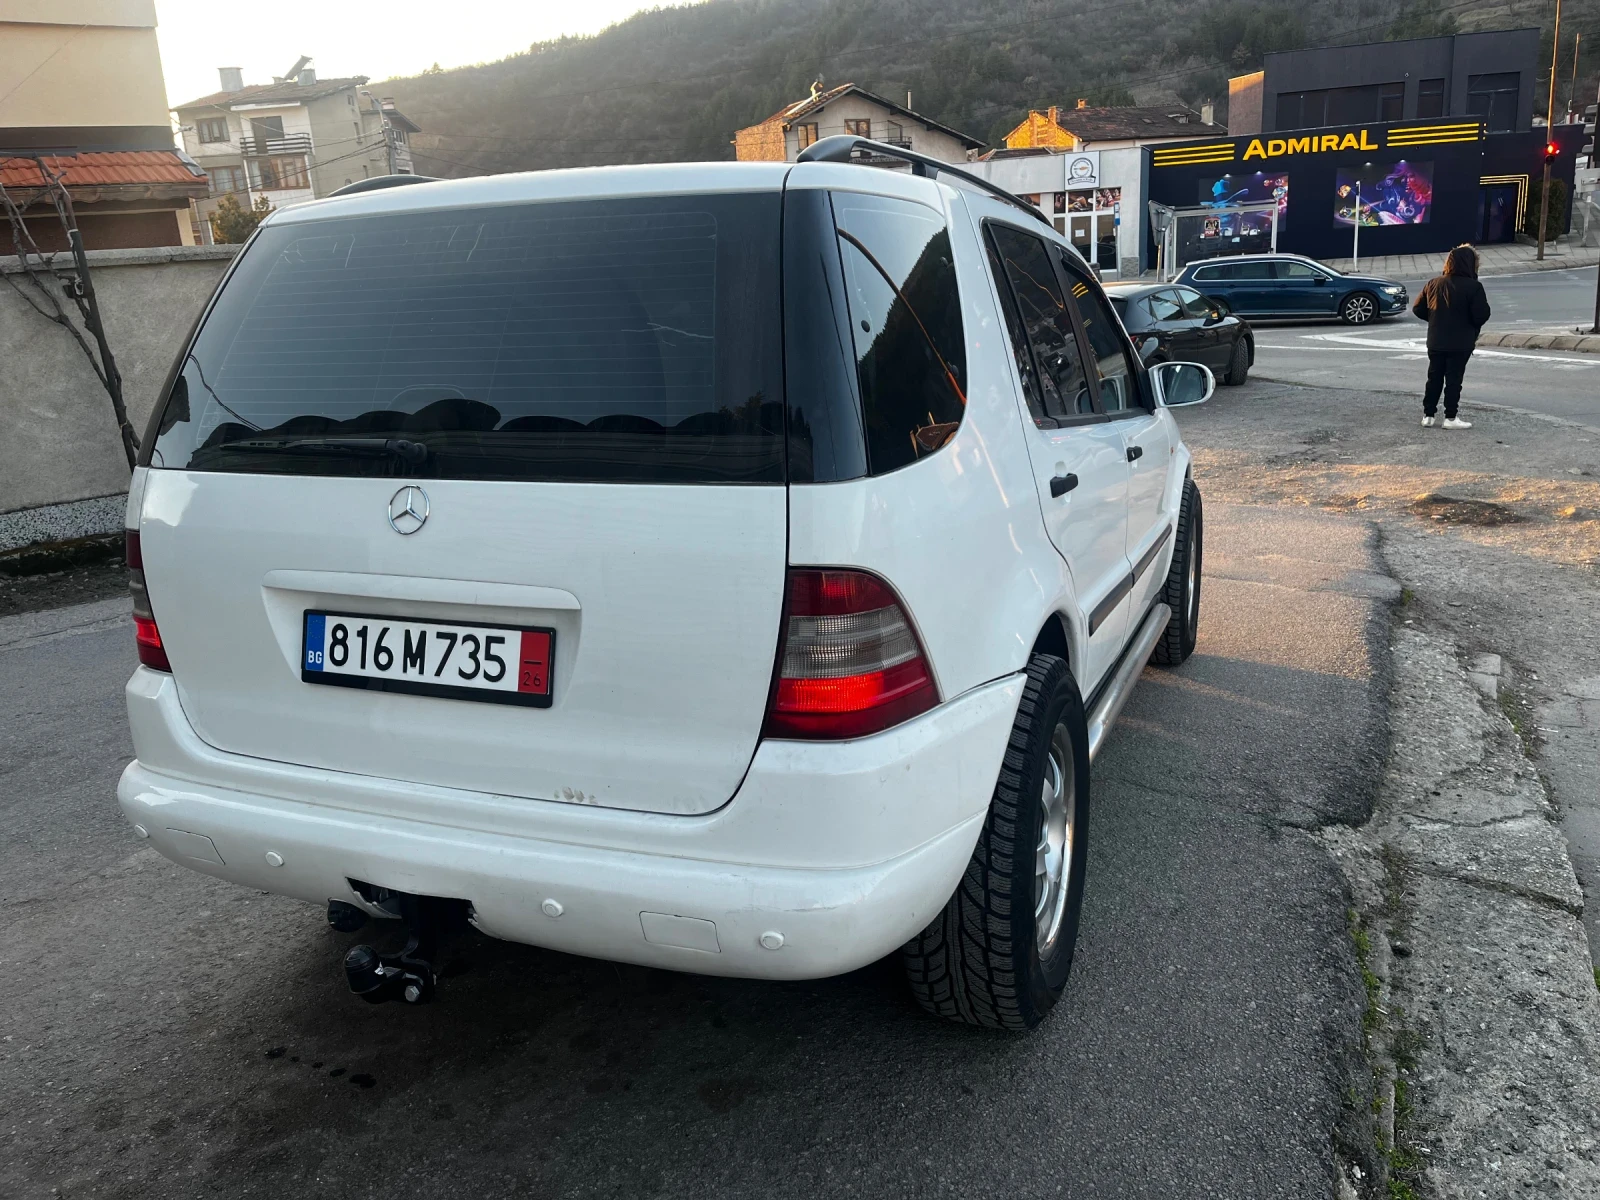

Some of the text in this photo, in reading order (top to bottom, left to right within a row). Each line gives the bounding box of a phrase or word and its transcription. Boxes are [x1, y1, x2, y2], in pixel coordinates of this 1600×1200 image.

[1243, 129, 1378, 160] ADMIRAL
[308, 650, 322, 664] BG
[523, 671, 541, 687] 26
